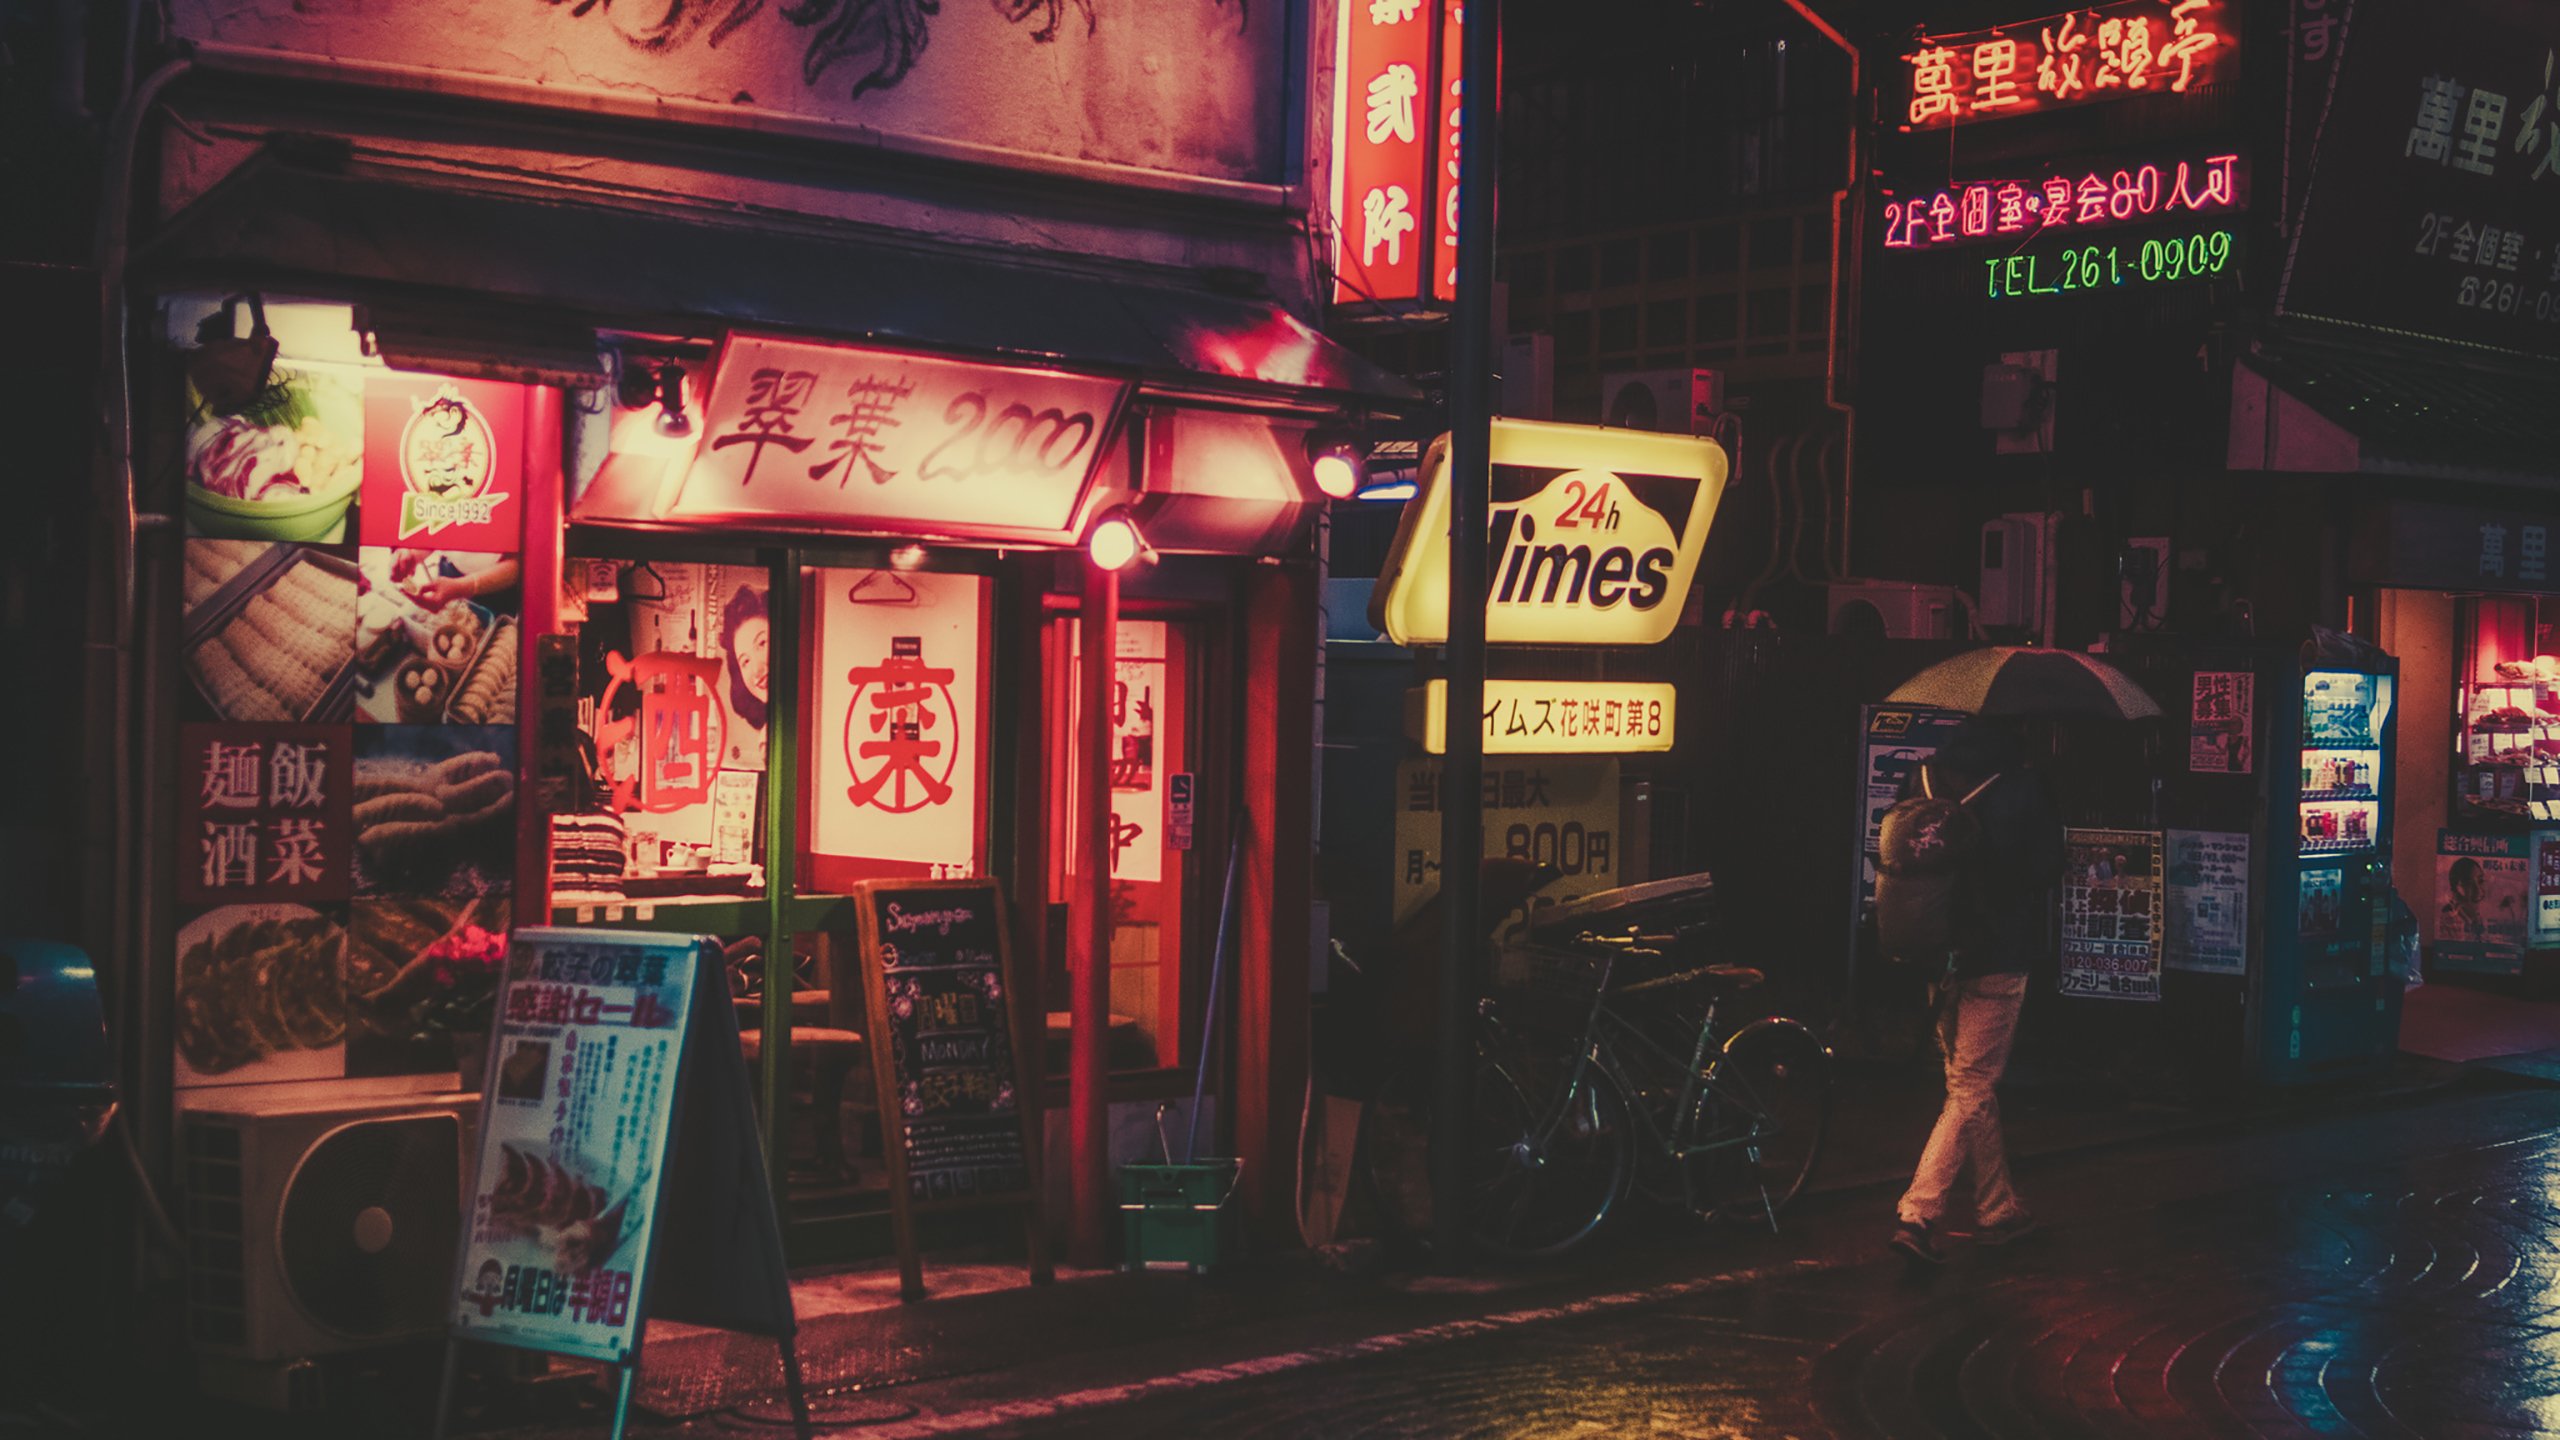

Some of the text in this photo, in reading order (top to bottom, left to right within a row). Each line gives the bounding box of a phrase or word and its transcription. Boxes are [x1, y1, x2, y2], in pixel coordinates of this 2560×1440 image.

[2061, 230, 2234, 291] 261-0909
[1483, 699, 1662, 738] イムズ花咲町第8
[201, 741, 327, 809] 麺飯
[201, 818, 325, 886] 酒菜
